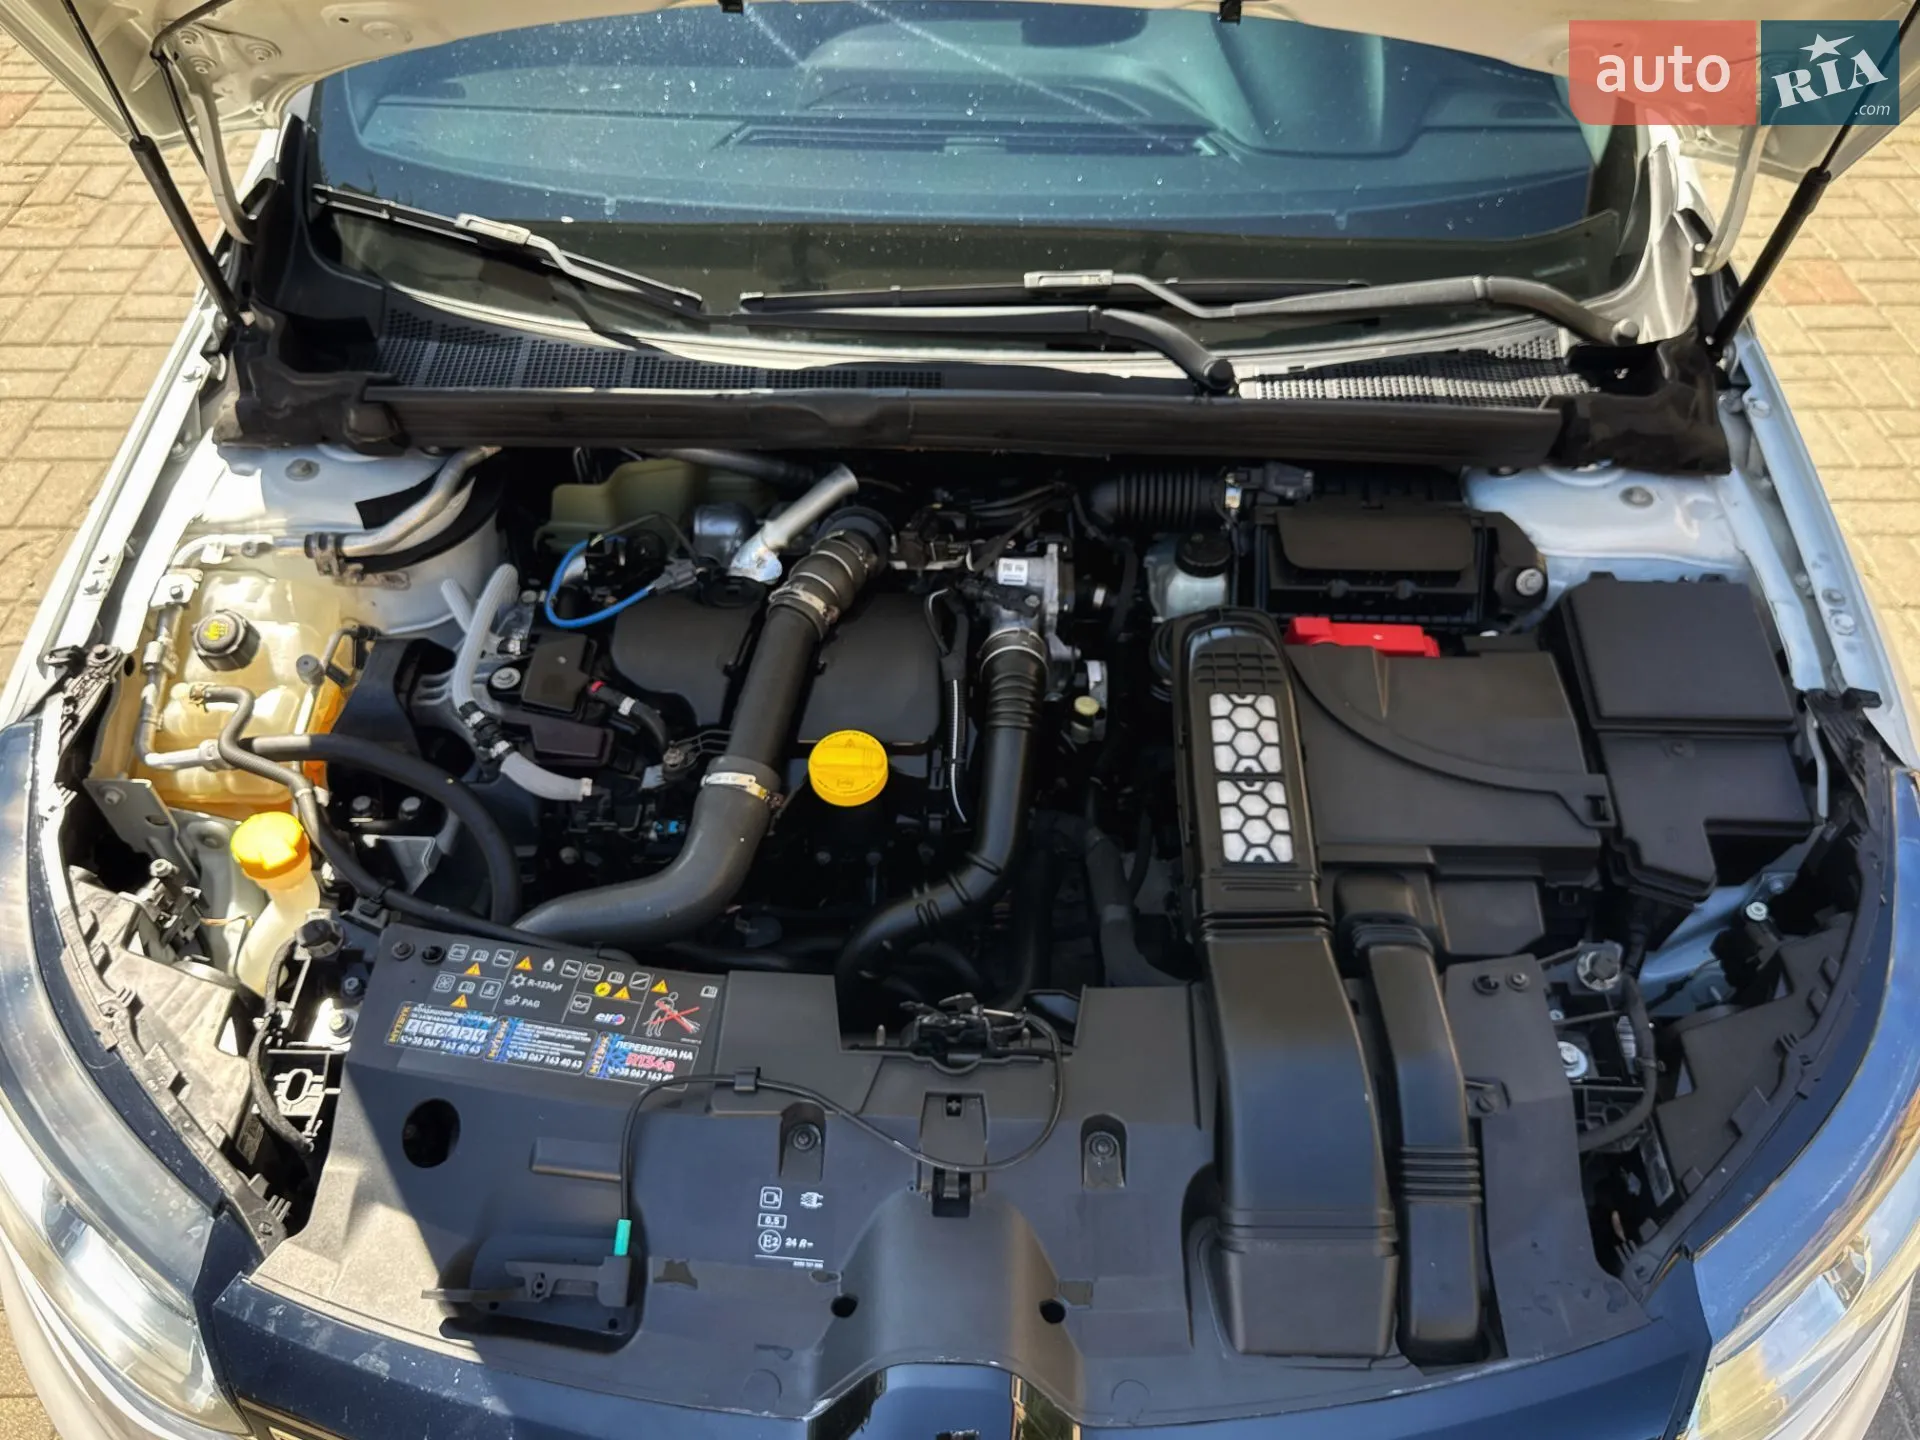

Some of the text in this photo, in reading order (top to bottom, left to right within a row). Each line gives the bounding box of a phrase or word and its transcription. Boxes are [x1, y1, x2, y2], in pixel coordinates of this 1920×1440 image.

[526, 979, 563, 992] R-1234yf
[521, 998, 541, 1008] PAG
[594, 1012, 614, 1023] elf
[423, 1038, 440, 1047] 067
[457, 1042, 469, 1051] 40
[615, 1040, 678, 1058] ПЕРЕВЕДЕНА
[679, 1050, 693, 1061] НА
[528, 1053, 543, 1062] 067
[545, 1055, 560, 1065] 163
[560, 1058, 571, 1067] 40
[571, 1060, 582, 1069] 63
[630, 1069, 646, 1078] 067
[647, 1071, 662, 1082] 163
[764, 1215, 780, 1225] 0.5
[763, 1234, 779, 1248] E2
[785, 1237, 797, 1247] 24
